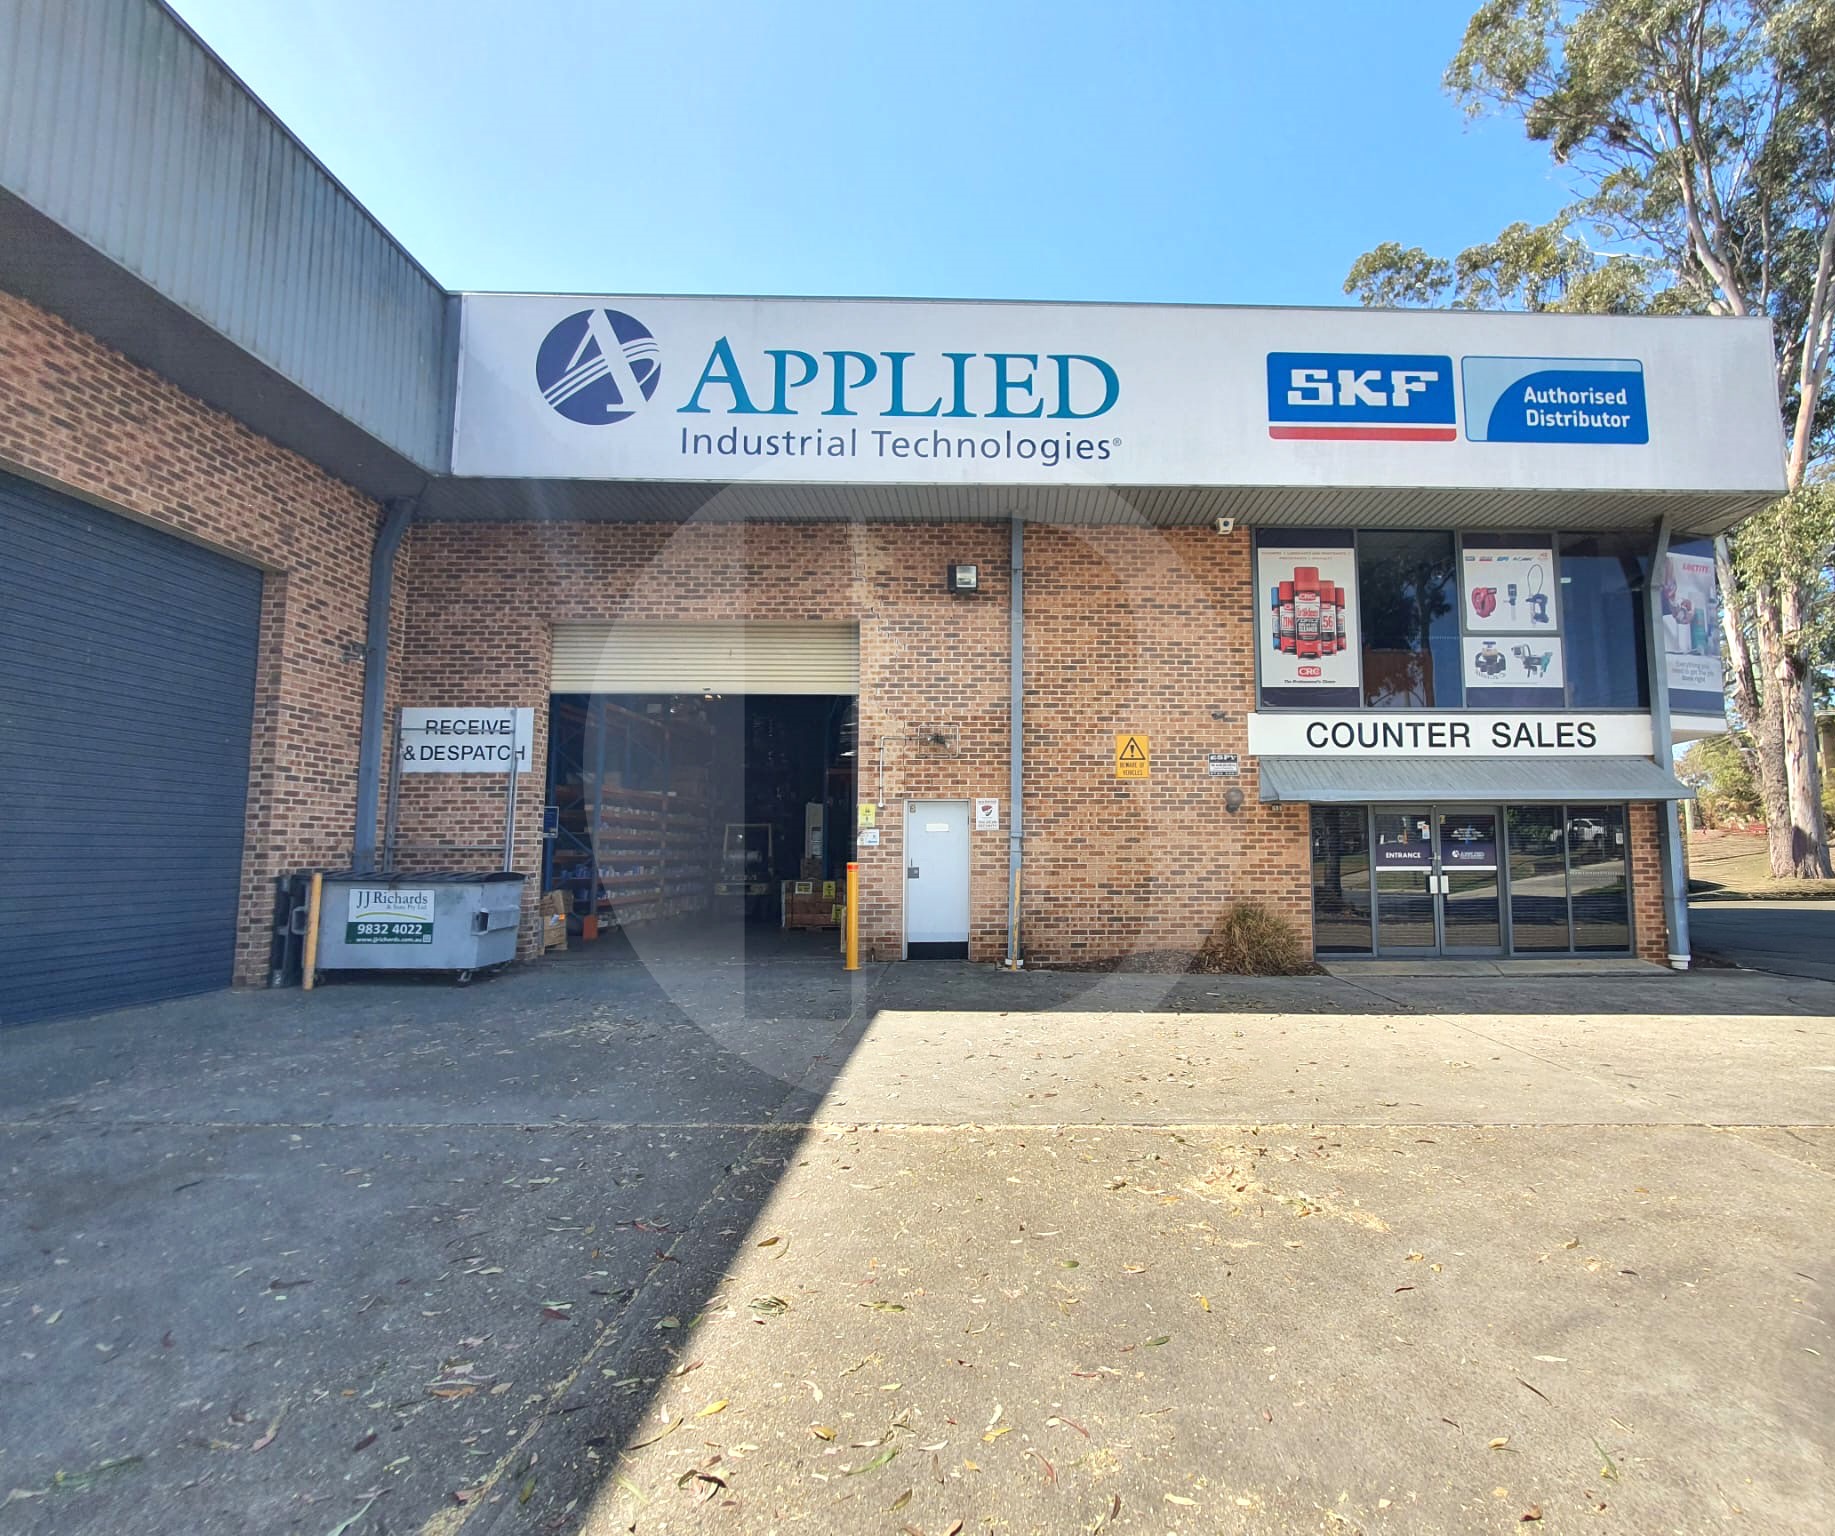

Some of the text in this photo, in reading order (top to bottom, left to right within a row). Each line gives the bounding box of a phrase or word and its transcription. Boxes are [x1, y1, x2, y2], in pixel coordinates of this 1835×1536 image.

[676, 335, 1120, 419] APPLIED
[1287, 368, 1439, 407] SKF
[1523, 386, 1628, 406] Authorised
[1526, 409, 1631, 428] Distributor
[681, 426, 857, 457] Industrial
[425, 719, 511, 736] RECEIVE
[1306, 721, 1597, 749] COUNTER SALES
[403, 745, 525, 761] & DESPATCH
[1385, 851, 1421, 859] ENTRANCE
[373, 890, 428, 905] Richards
[357, 923, 423, 935] 9832 4022
